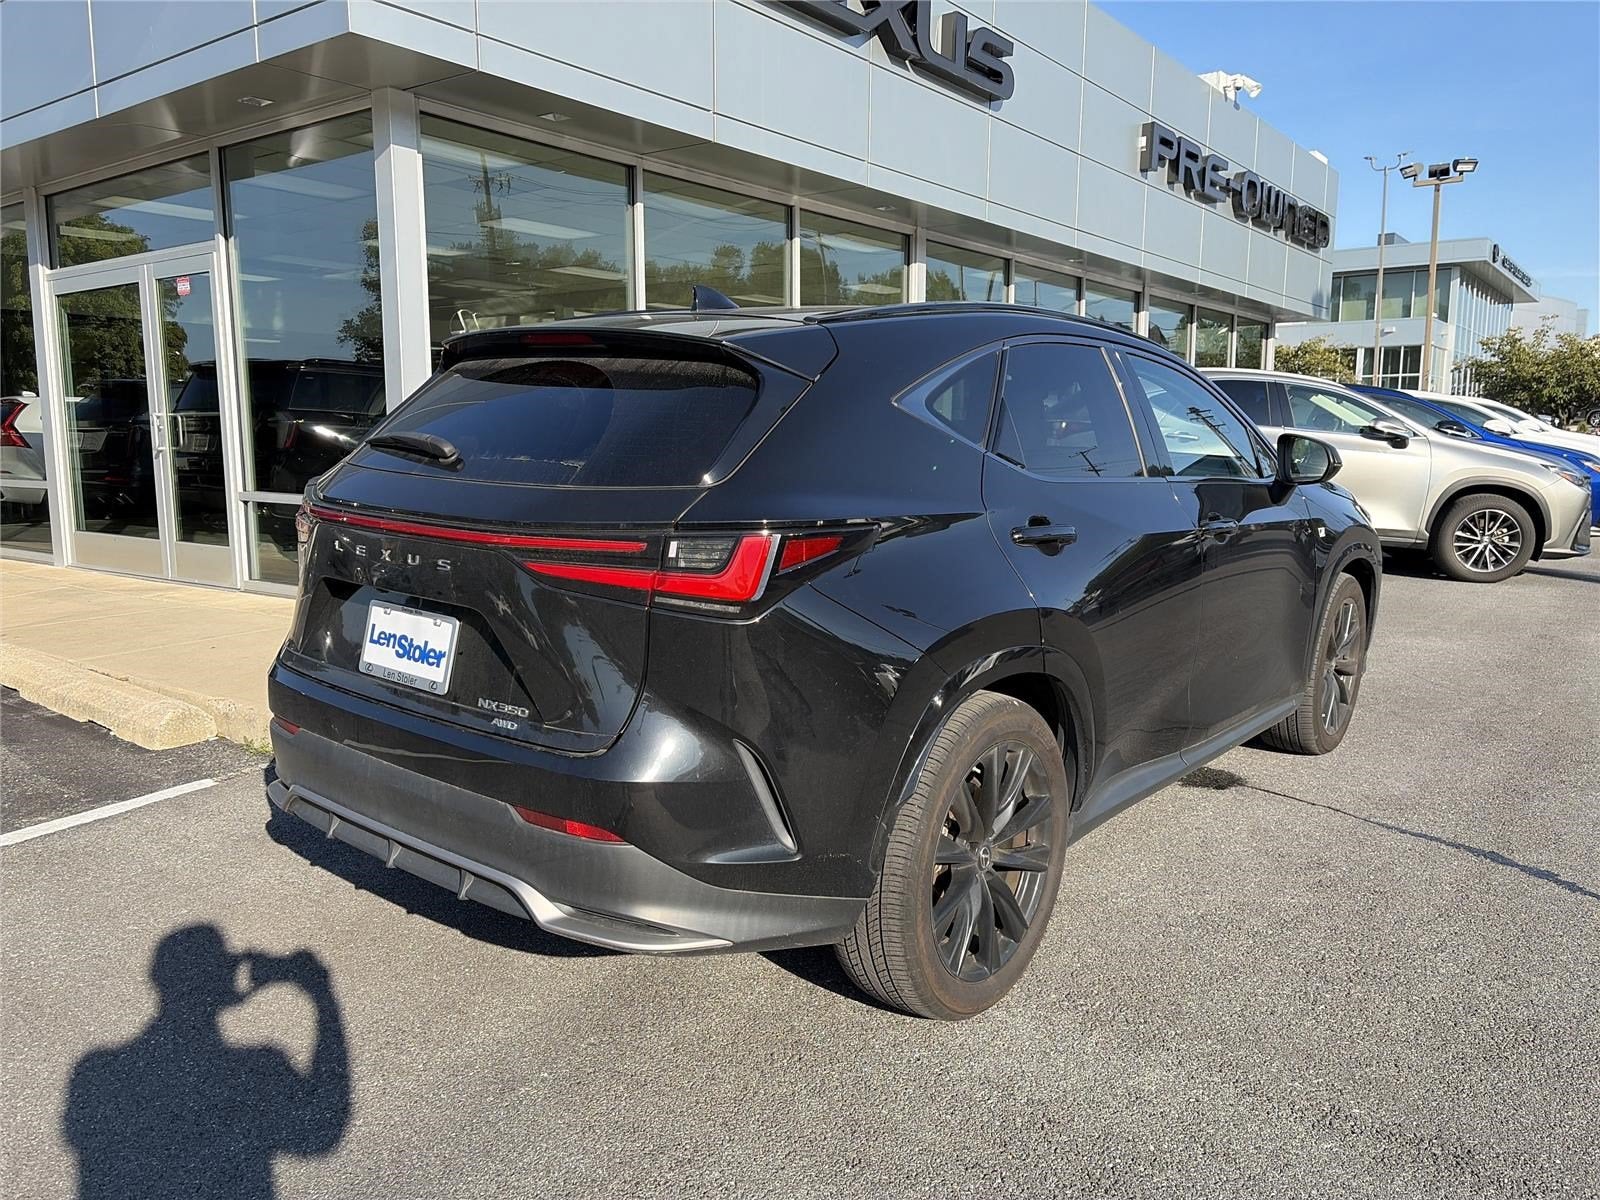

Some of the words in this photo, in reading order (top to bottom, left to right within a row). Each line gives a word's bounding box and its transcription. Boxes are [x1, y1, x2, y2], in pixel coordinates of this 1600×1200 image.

[1140, 121, 1330, 251] PRE-OWNED
[334, 540, 451, 571] LEXUS
[382, 667, 395, 680] Len
[396, 671, 417, 686] Stoler
[477, 697, 529, 718] NX350
[490, 718, 518, 730] AWD
